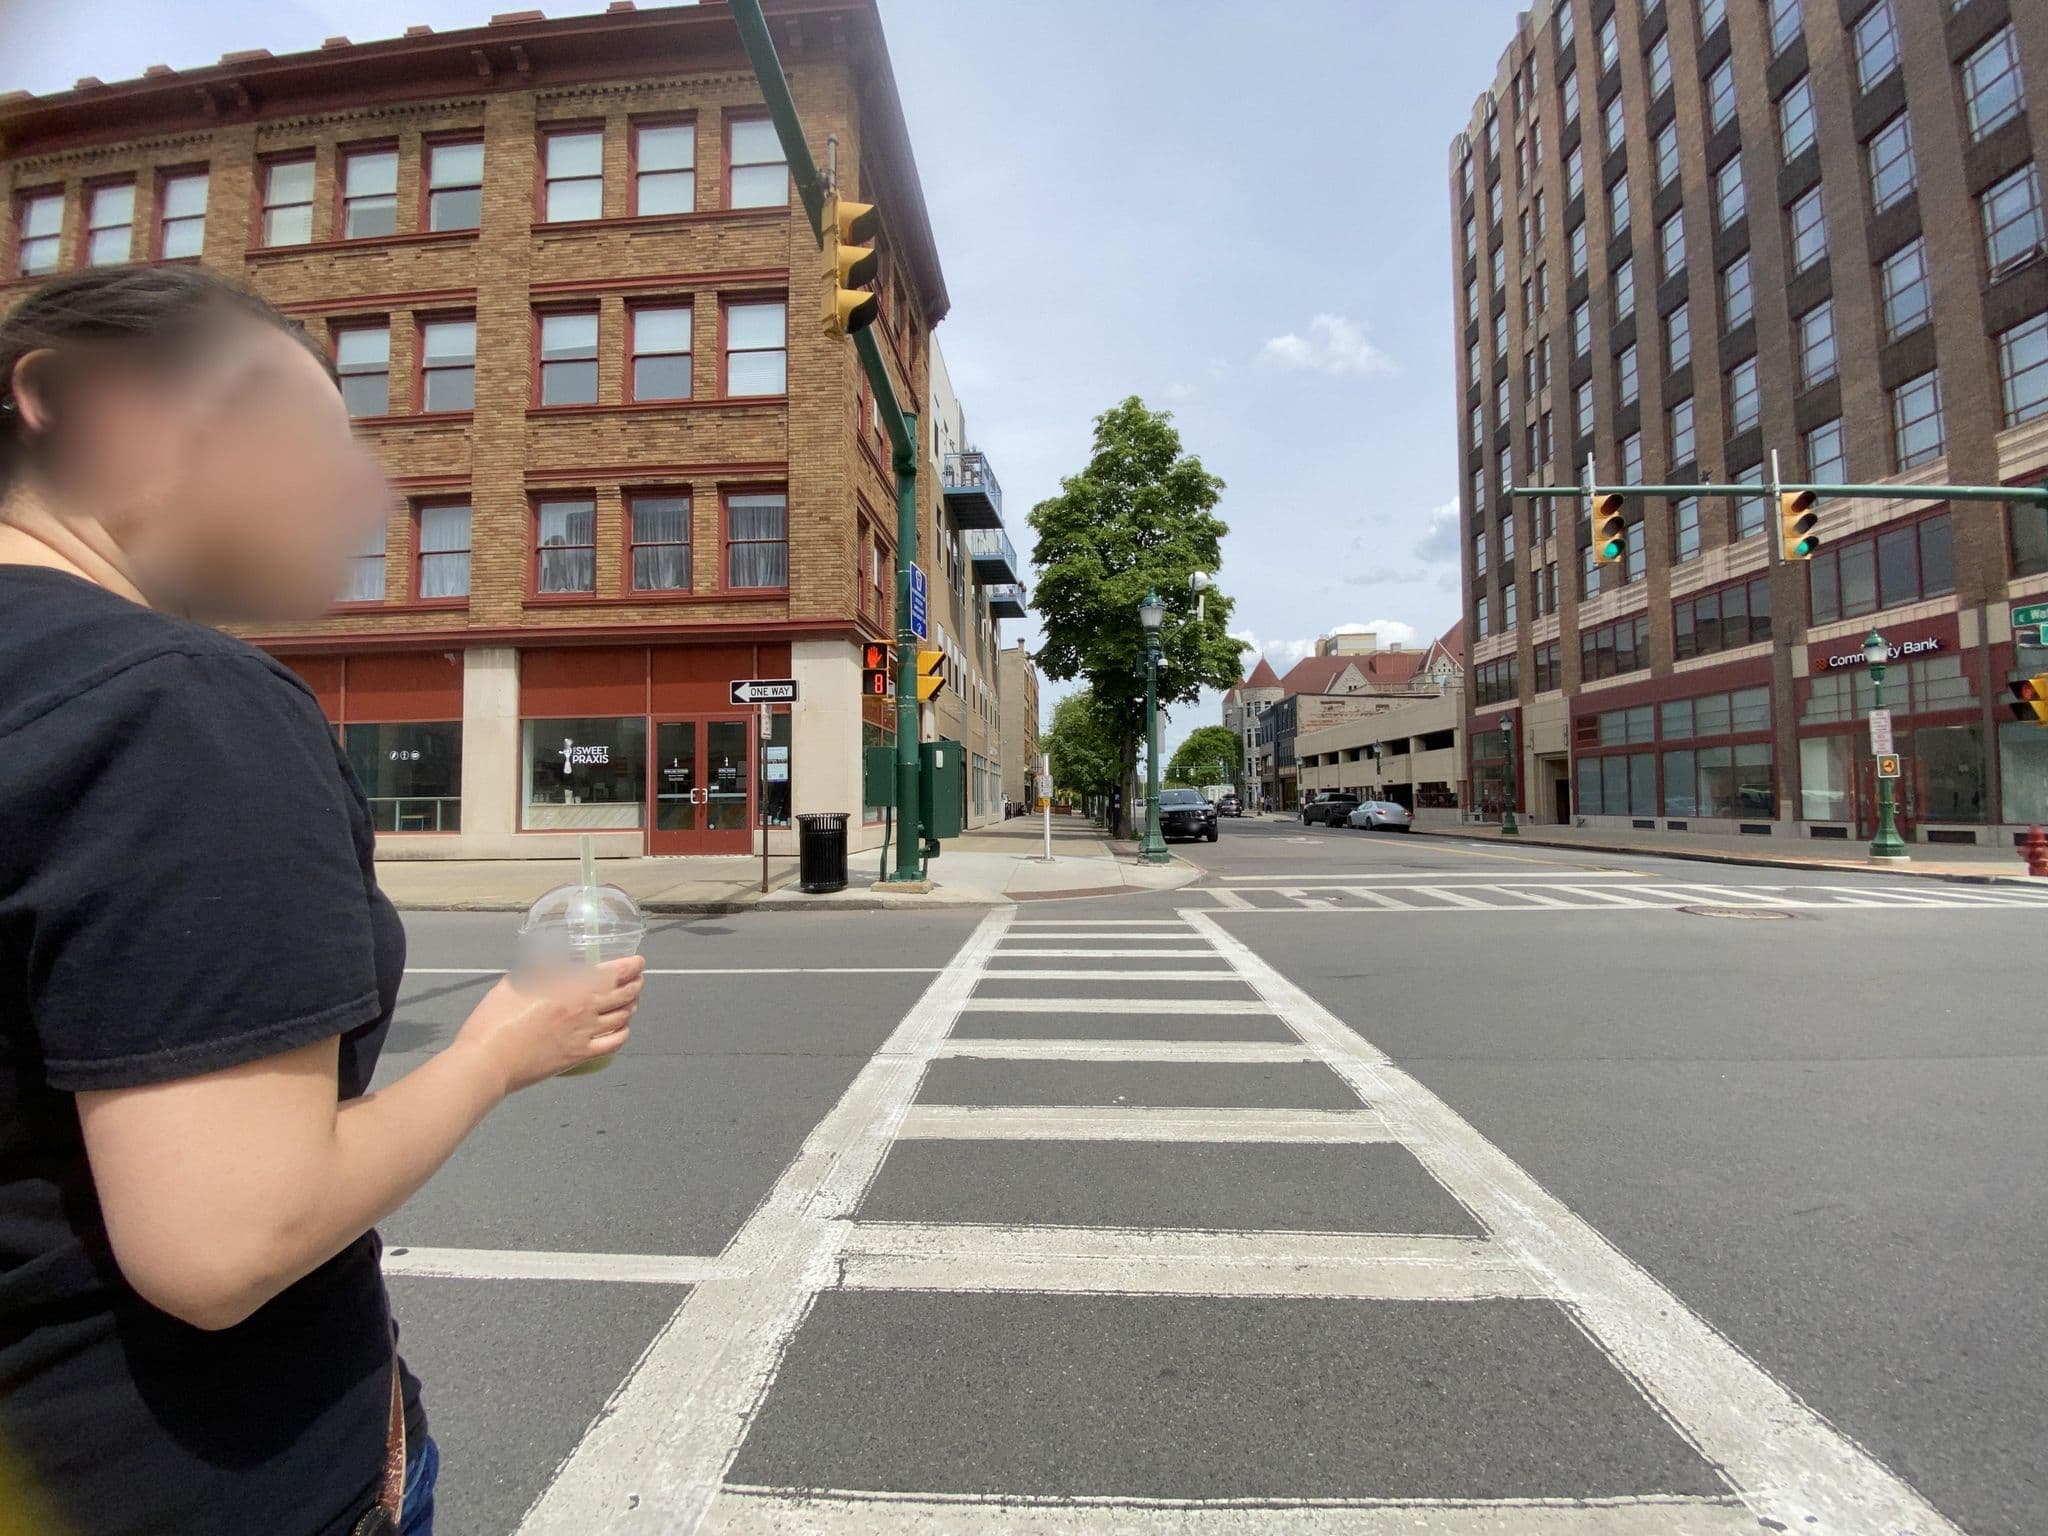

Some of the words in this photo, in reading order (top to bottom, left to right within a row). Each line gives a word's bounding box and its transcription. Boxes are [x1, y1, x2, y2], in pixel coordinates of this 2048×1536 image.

[2030, 608, 2048, 620] Wa
[1903, 638, 1938, 654] Bank
[875, 674, 883, 693] 8
[750, 687, 768, 696] ONE
[771, 687, 790, 696] WAY
[576, 746, 609, 755] SWEET
[572, 754, 609, 764] PRAXIS
